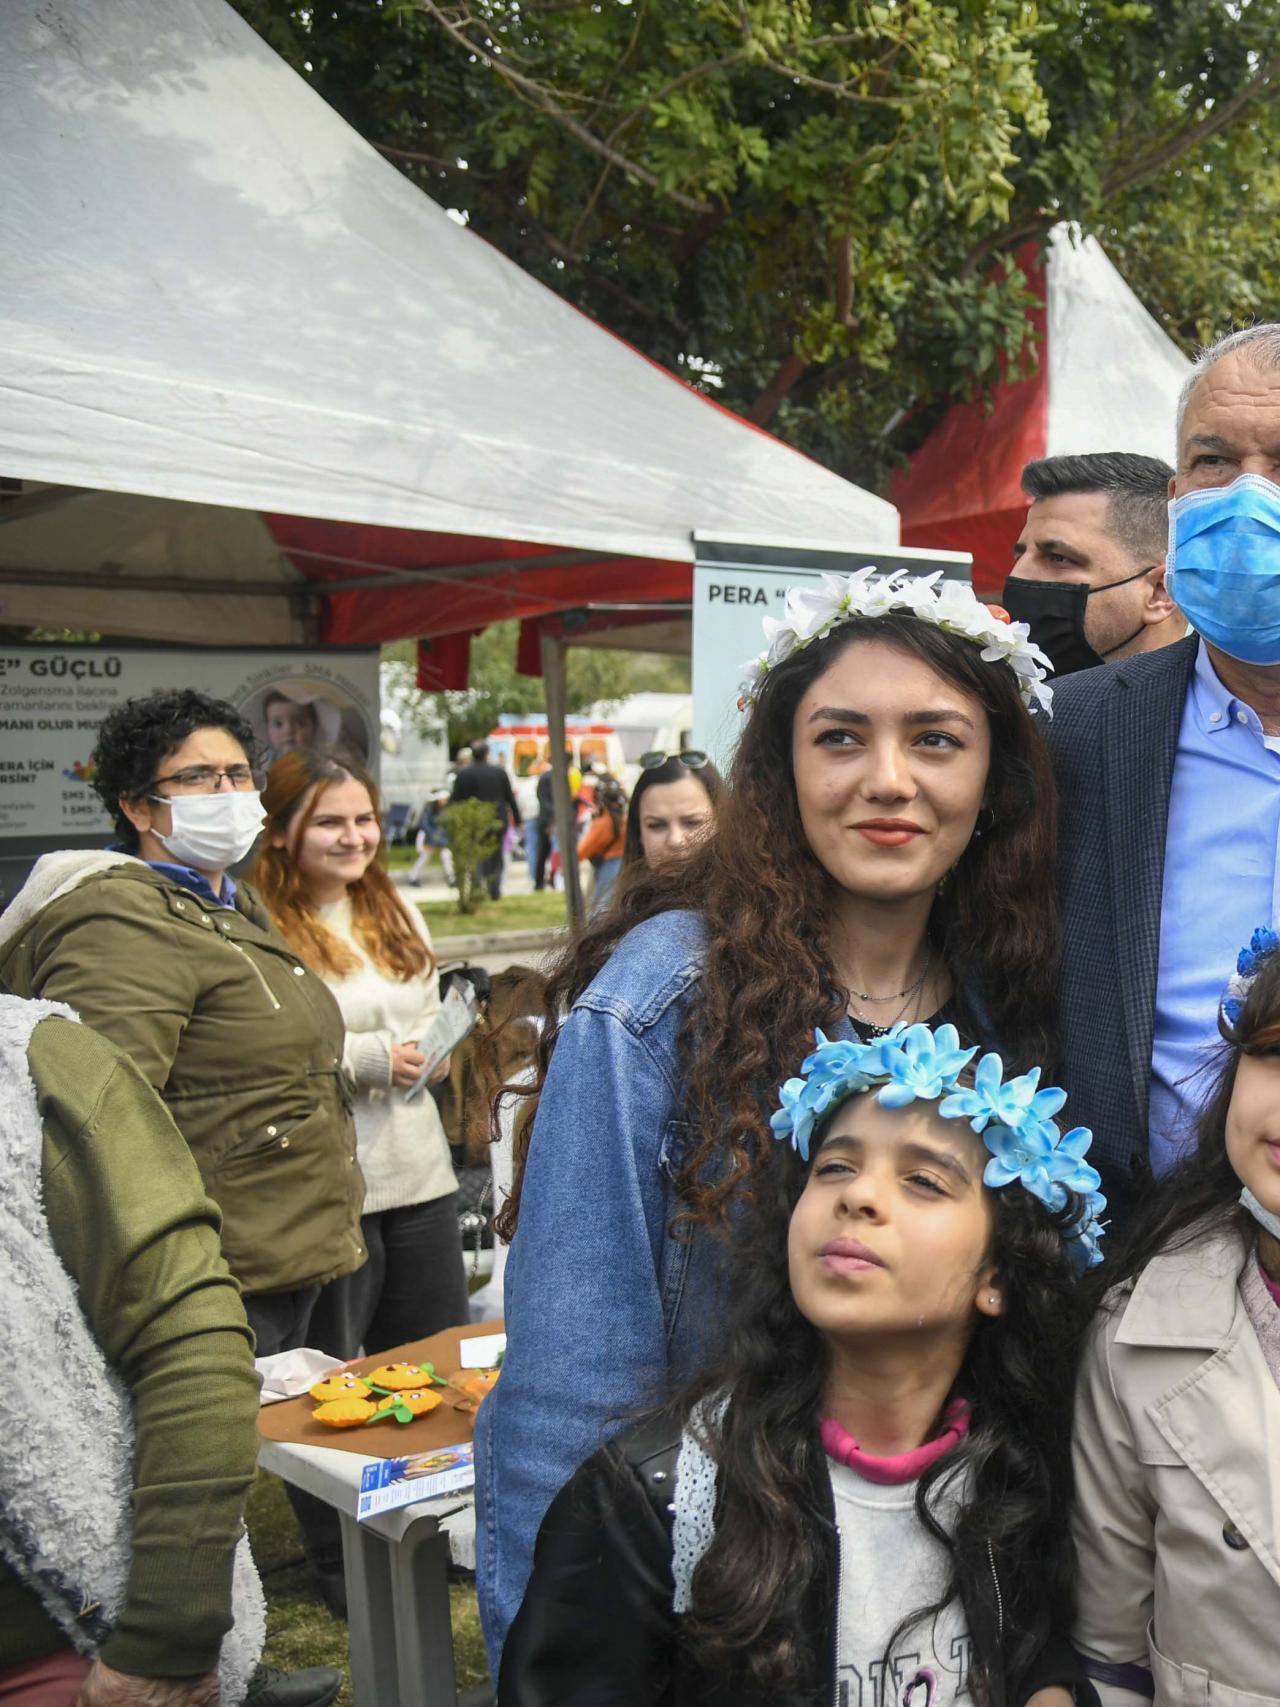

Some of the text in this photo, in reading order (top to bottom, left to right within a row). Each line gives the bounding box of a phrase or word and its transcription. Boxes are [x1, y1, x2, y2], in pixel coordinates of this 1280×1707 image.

[709, 584, 768, 606] PERA
[30, 655, 121, 680] GÜÇLÜ
[1, 684, 74, 698] Zolgensma
[37, 720, 74, 730] OLUR
[28, 759, 55, 771] İÇİN
